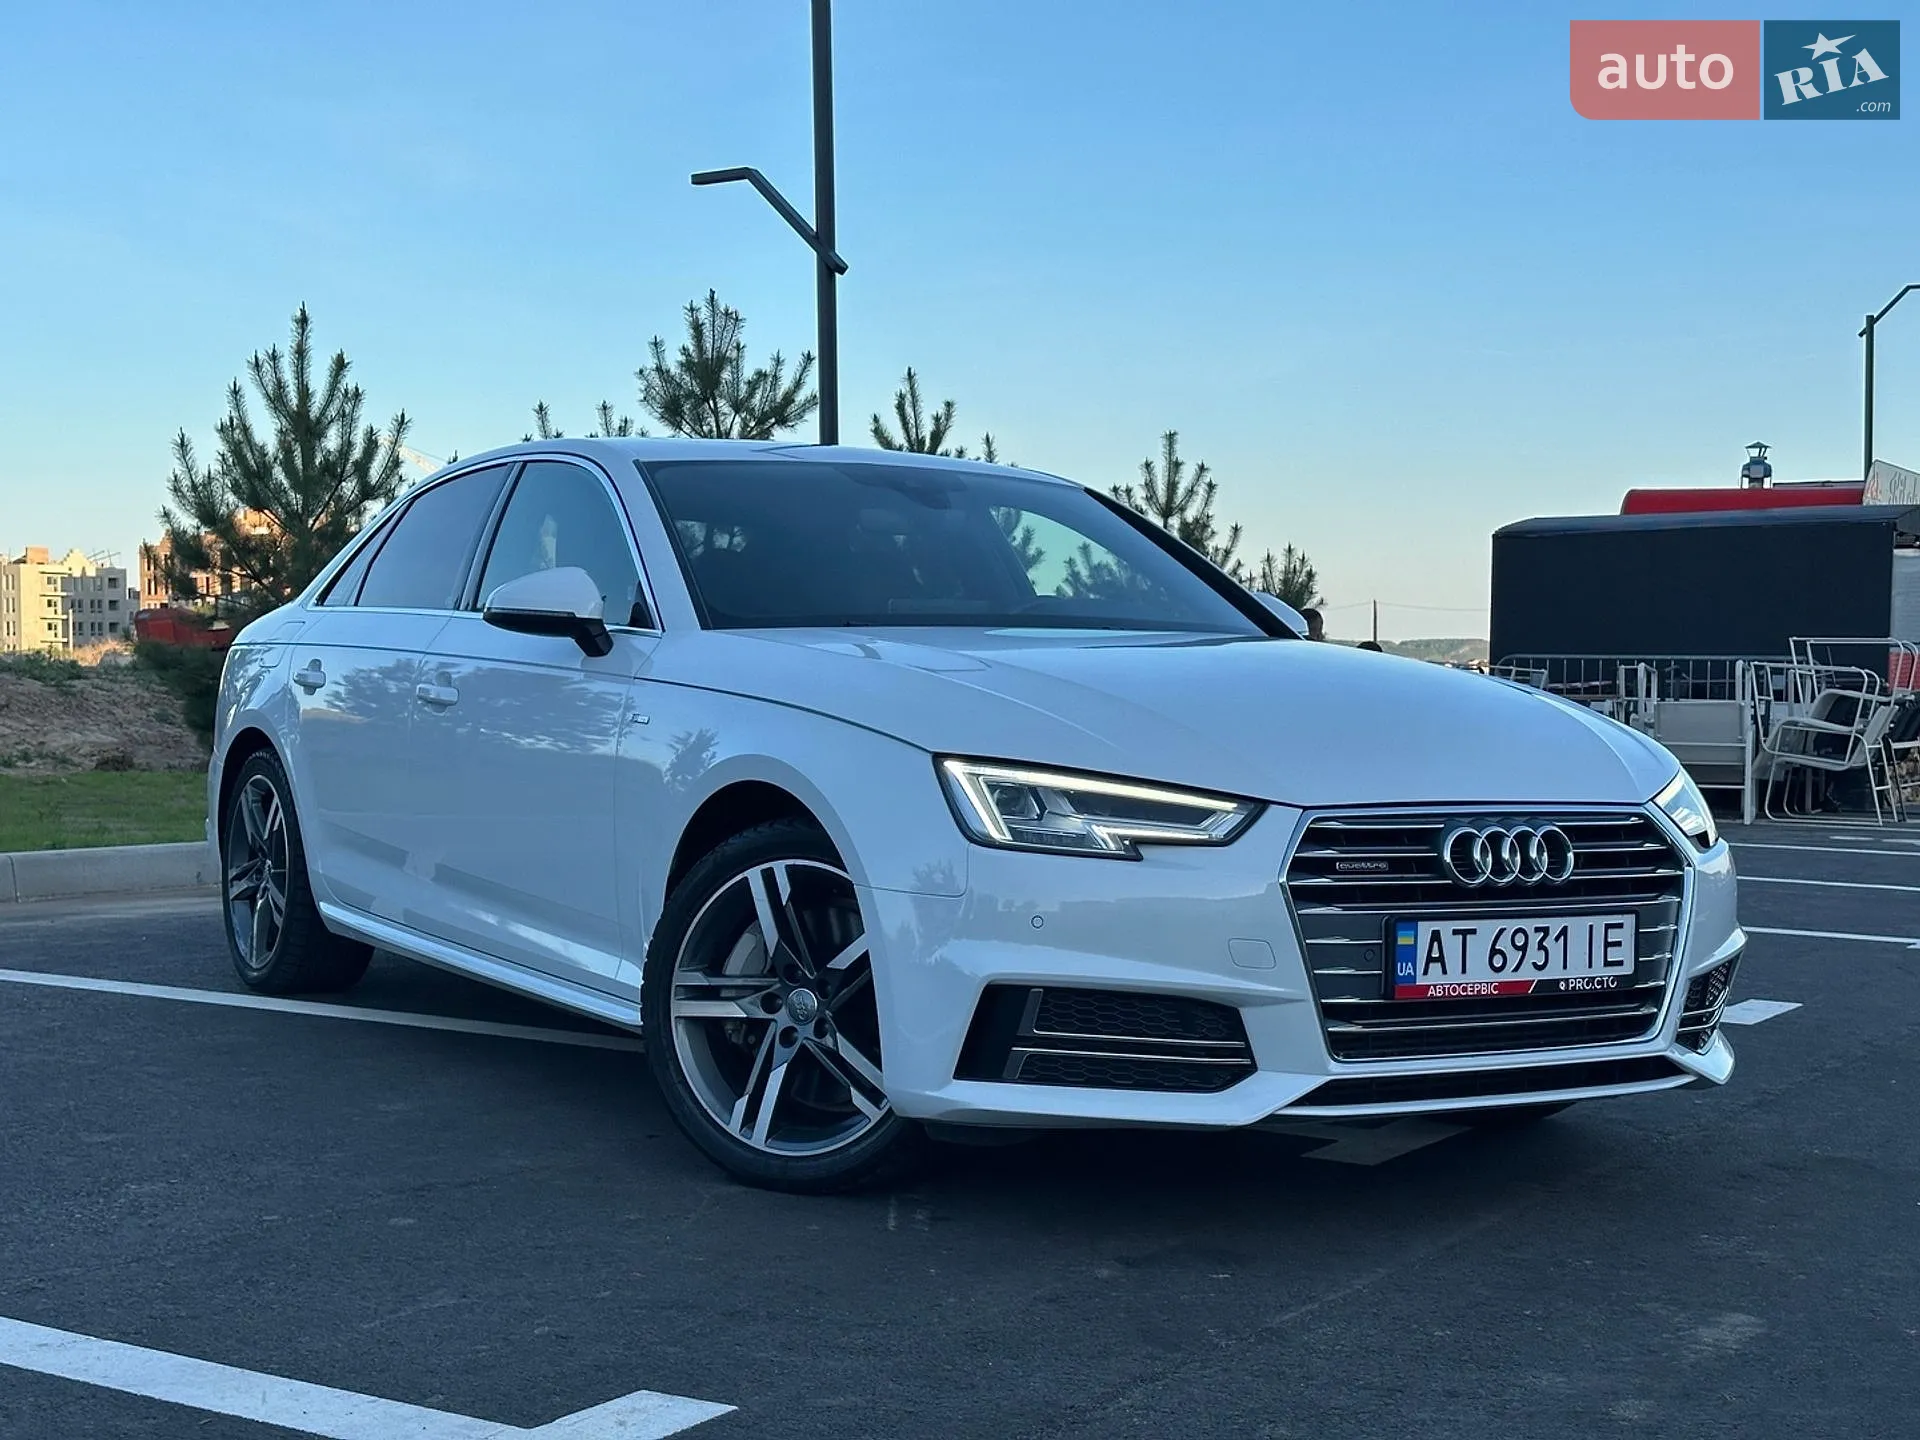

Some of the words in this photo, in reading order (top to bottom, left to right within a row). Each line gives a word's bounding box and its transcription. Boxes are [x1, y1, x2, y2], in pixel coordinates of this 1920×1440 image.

[1422, 927, 1477, 976] AT
[1487, 925, 1569, 974] 6931
[1587, 921, 1624, 969] IE
[1397, 962, 1415, 976] UA
